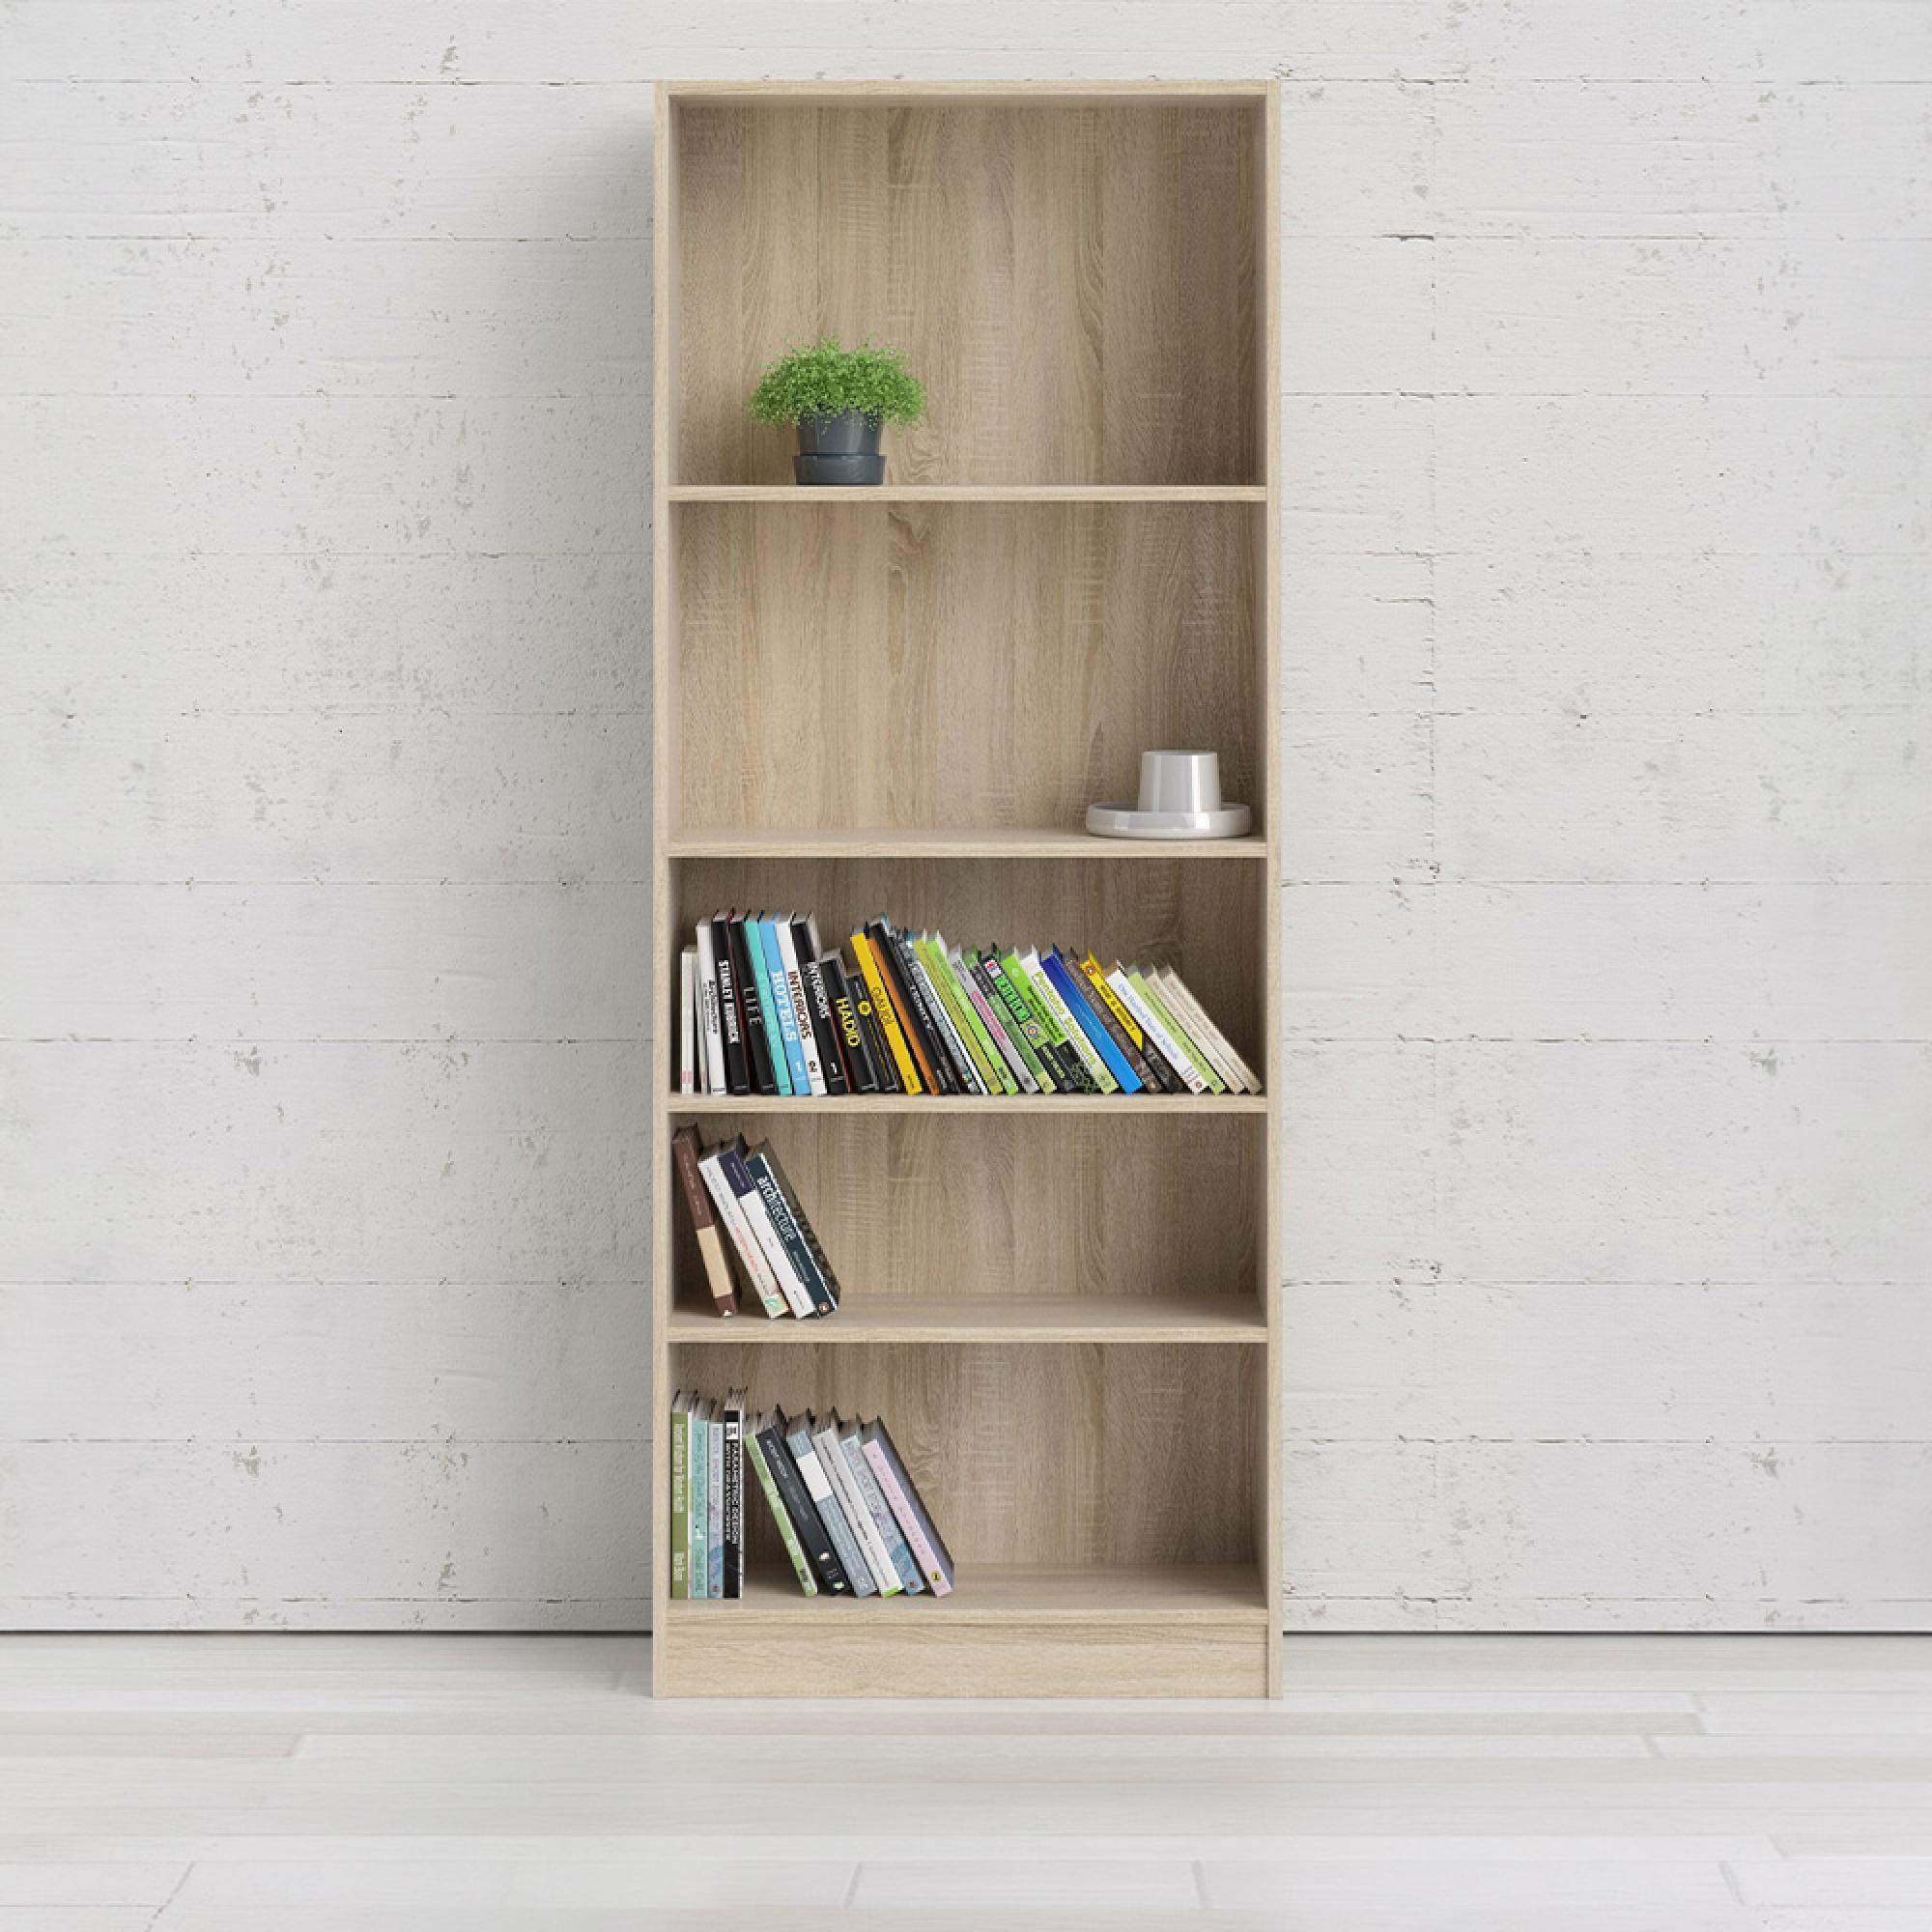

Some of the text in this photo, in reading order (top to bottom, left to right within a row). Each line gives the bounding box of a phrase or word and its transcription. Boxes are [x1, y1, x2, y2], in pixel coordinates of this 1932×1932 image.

[718, 959, 740, 1043] STANLEY KUBRICK
[742, 986, 761, 1026] LIFE
[769, 969, 798, 1041] HOTELS
[786, 970, 811, 1039] INTERIORS
[805, 960, 831, 1019] INTERIORS
[834, 996, 863, 1047] HADID
[1062, 1015, 1100, 1066] Solutions
[755, 1174, 799, 1242] architecture
